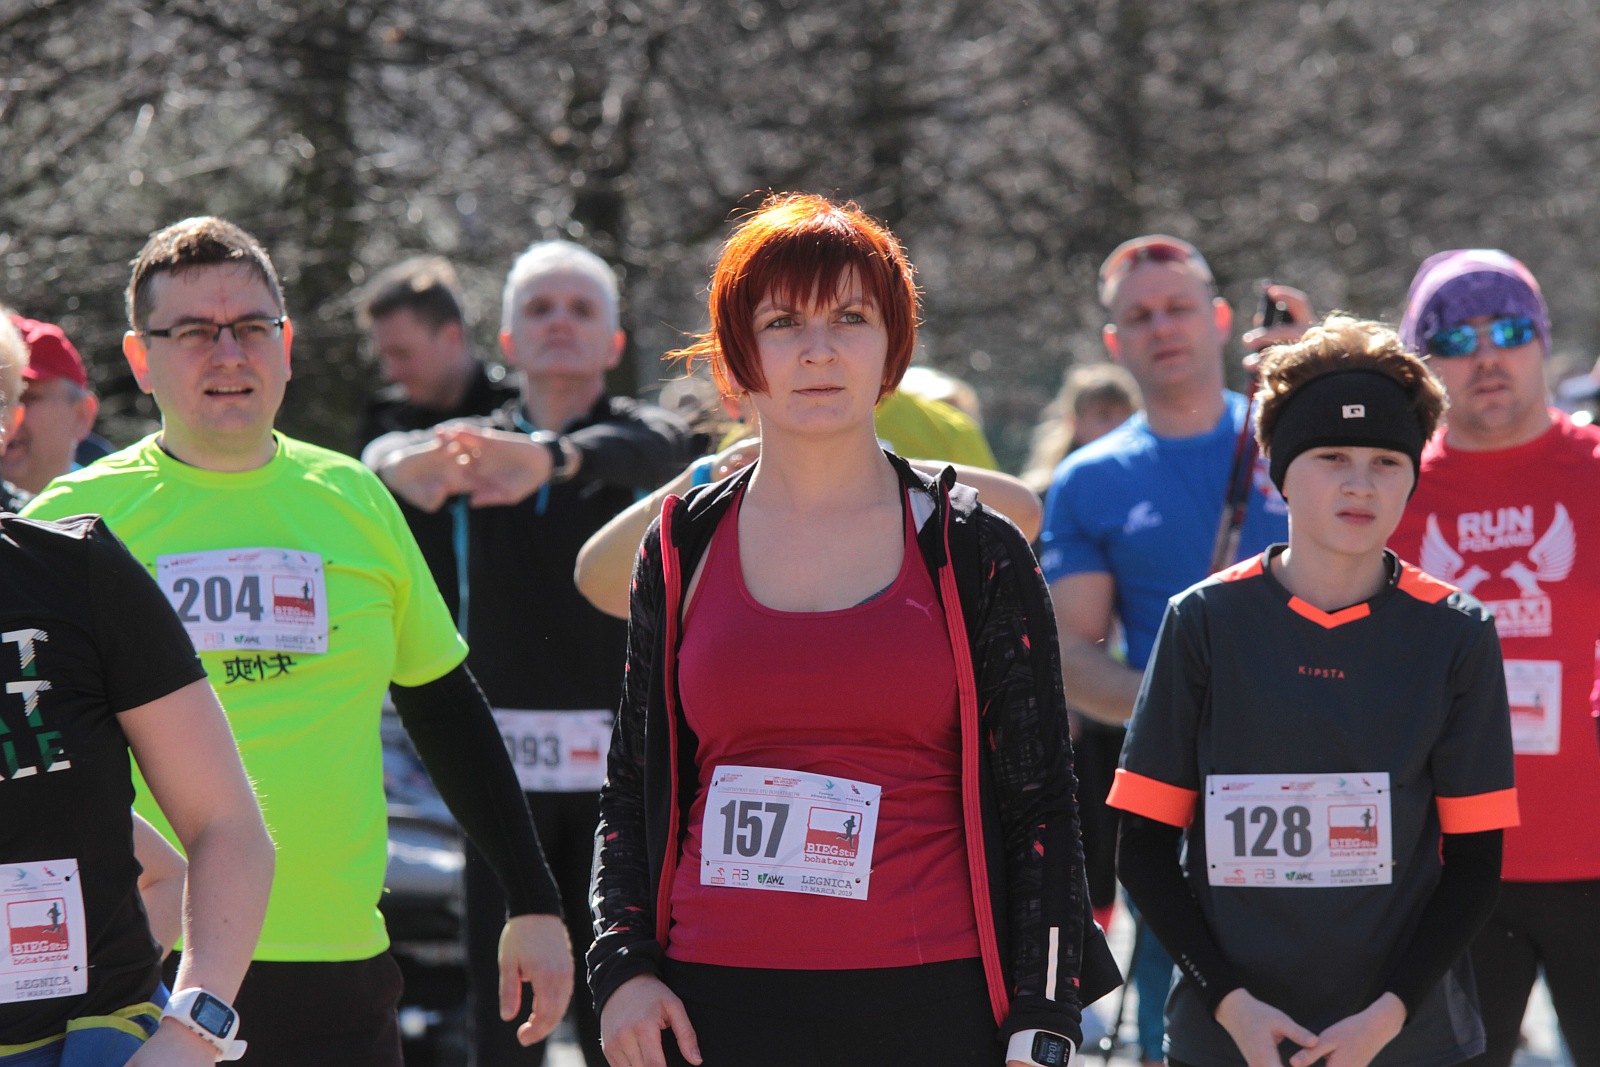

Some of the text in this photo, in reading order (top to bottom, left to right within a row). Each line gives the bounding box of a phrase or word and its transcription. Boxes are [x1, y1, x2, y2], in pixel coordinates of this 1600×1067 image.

[1457, 505, 1534, 540] RUN
[1459, 533, 1535, 553] POLAND
[173, 575, 264, 622] 204
[1298, 666, 1345, 679] KIPSTA
[720, 799, 790, 858] 157
[1225, 806, 1312, 857] 128
[804, 855, 855, 867] bohaterów
[801, 875, 853, 889] LEGNICA
[810, 886, 835, 895] MARCA
[15, 976, 71, 990] LEGNICA
[1046, 1041, 1057, 1064] 10:48
